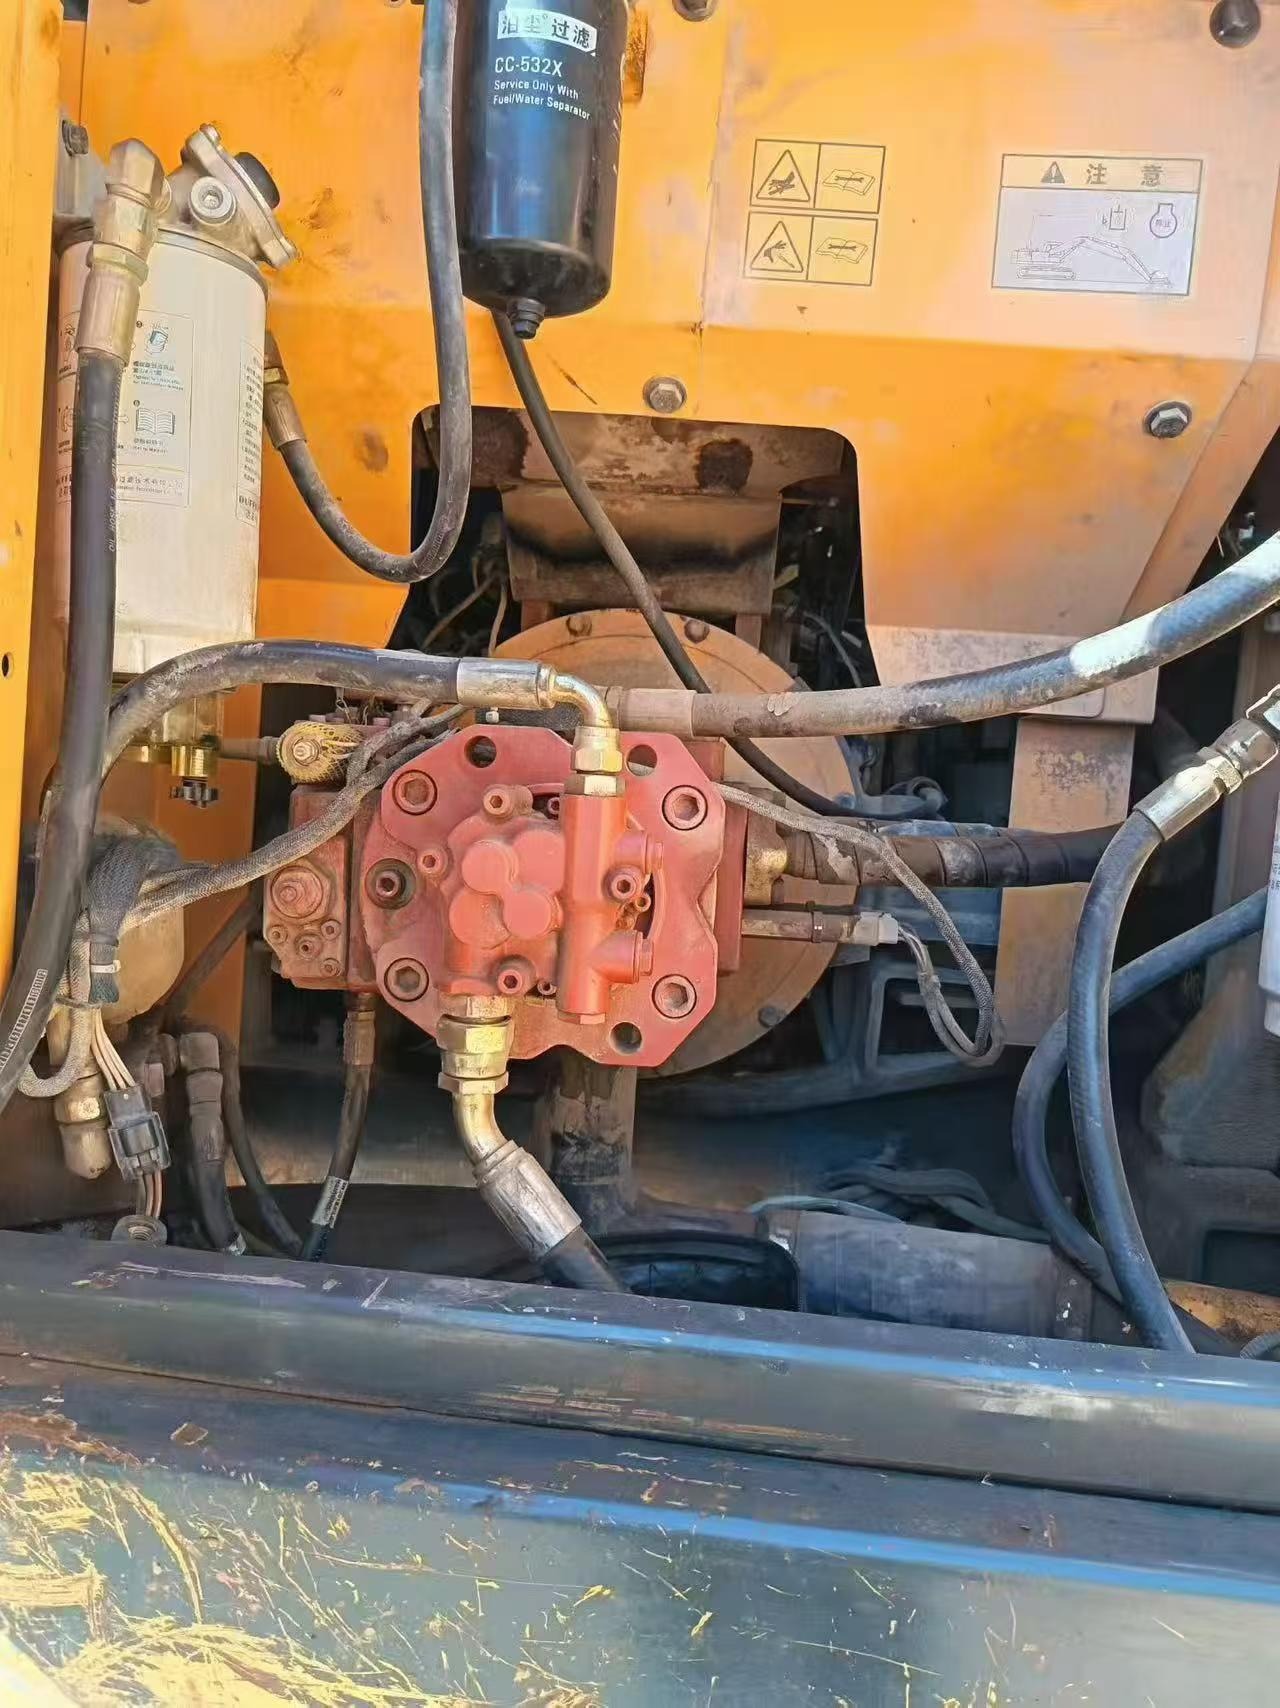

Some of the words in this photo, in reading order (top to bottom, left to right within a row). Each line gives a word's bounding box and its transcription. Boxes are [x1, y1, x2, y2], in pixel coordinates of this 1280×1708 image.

[495, 55, 562, 77] CC-532X
[494, 79, 530, 91] Service
[532, 79, 555, 94] Only
[557, 84, 579, 100] With
[493, 93, 544, 105] Fuel/Water
[547, 97, 591, 121] Separator
